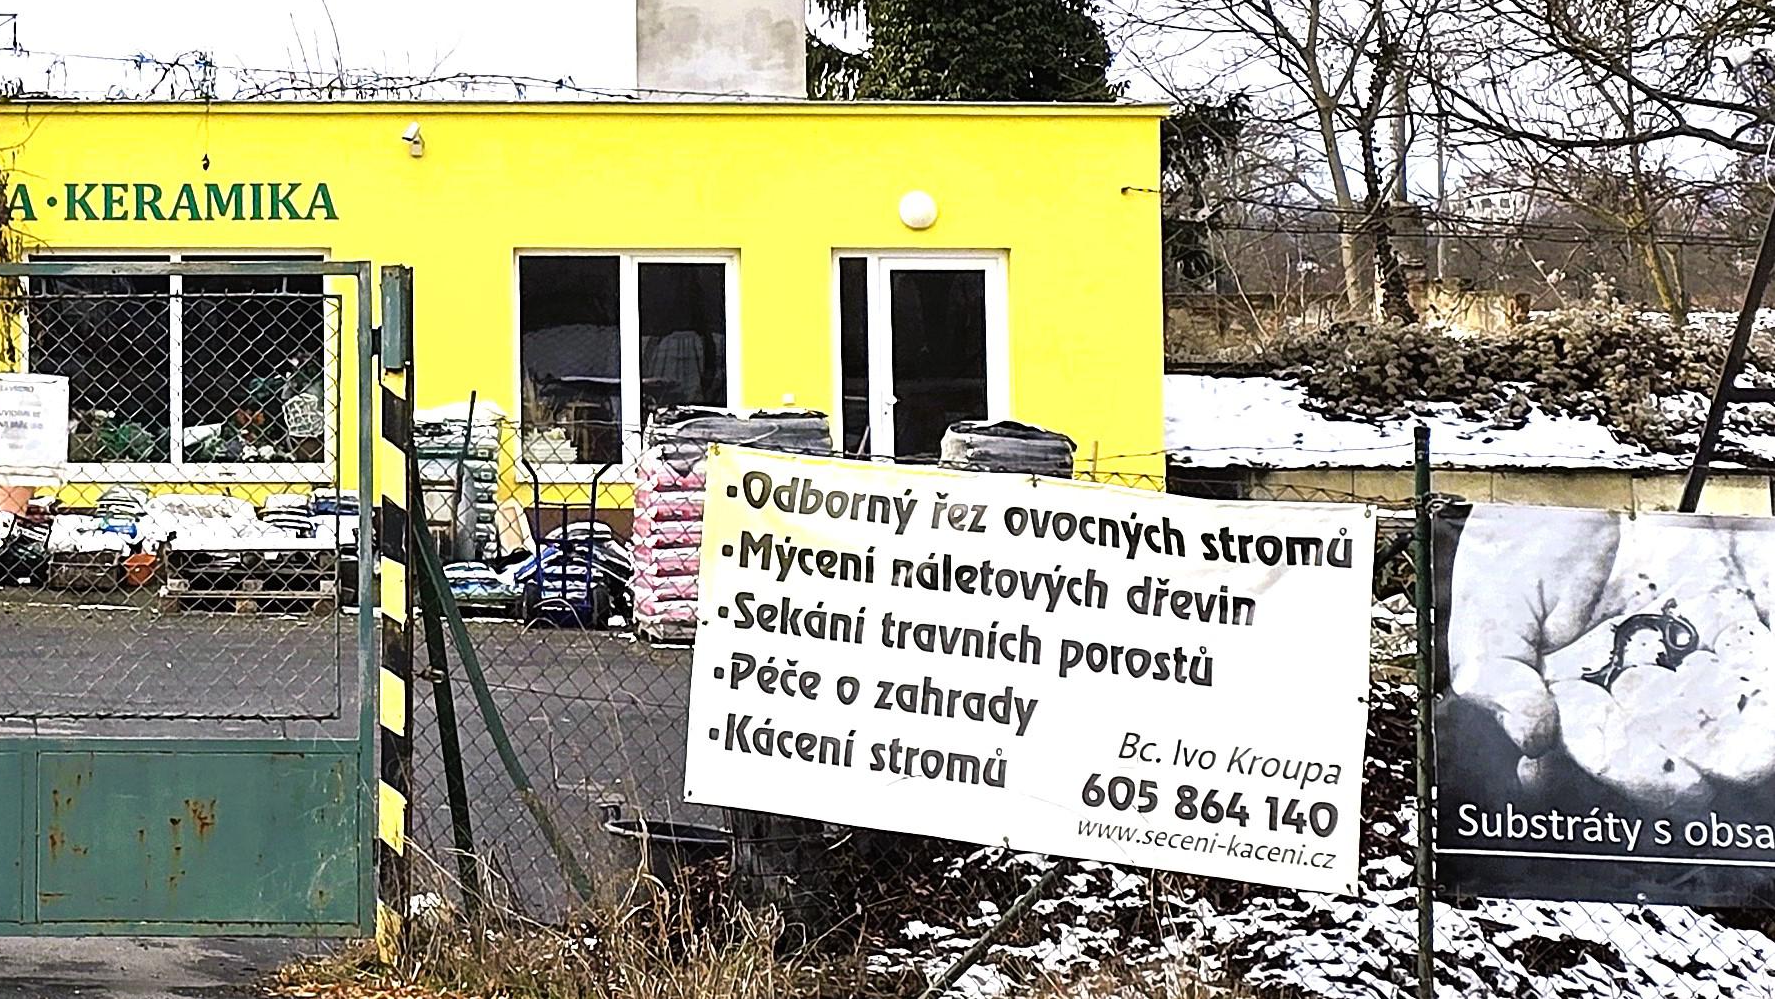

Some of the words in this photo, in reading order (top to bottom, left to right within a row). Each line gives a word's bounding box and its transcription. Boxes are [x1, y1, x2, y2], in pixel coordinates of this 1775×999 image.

[65, 182, 340, 221] KERAMIKA
[742, 470, 918, 536] Odborný
[930, 491, 988, 534] řez
[1003, 506, 1186, 560] ovocných
[1200, 526, 1353, 569] stromů
[738, 530, 875, 584] Mýcení
[890, 552, 1109, 613] náletových
[1126, 575, 1256, 626] dřevin
[733, 591, 867, 645] Sekání
[881, 611, 1042, 666] travních
[1058, 638, 1214, 687] porostů
[729, 651, 822, 701] Péče
[836, 675, 861, 706] o
[873, 675, 1039, 737] zahrady
[724, 712, 857, 768] Kácení
[869, 737, 1008, 789] stromů
[1118, 731, 1162, 764] Bc.
[1172, 739, 1217, 770] Ivo
[1226, 746, 1342, 790] Kroupa
[1081, 772, 1159, 814] 605
[1174, 784, 1250, 828] 864
[1264, 795, 1339, 838] 140
[1457, 802, 1643, 851] Substráty
[1653, 818, 1673, 845] s
[1683, 811, 1775, 850] obsa
[1077, 818, 1337, 870] www.seceni-kaceni.cz
